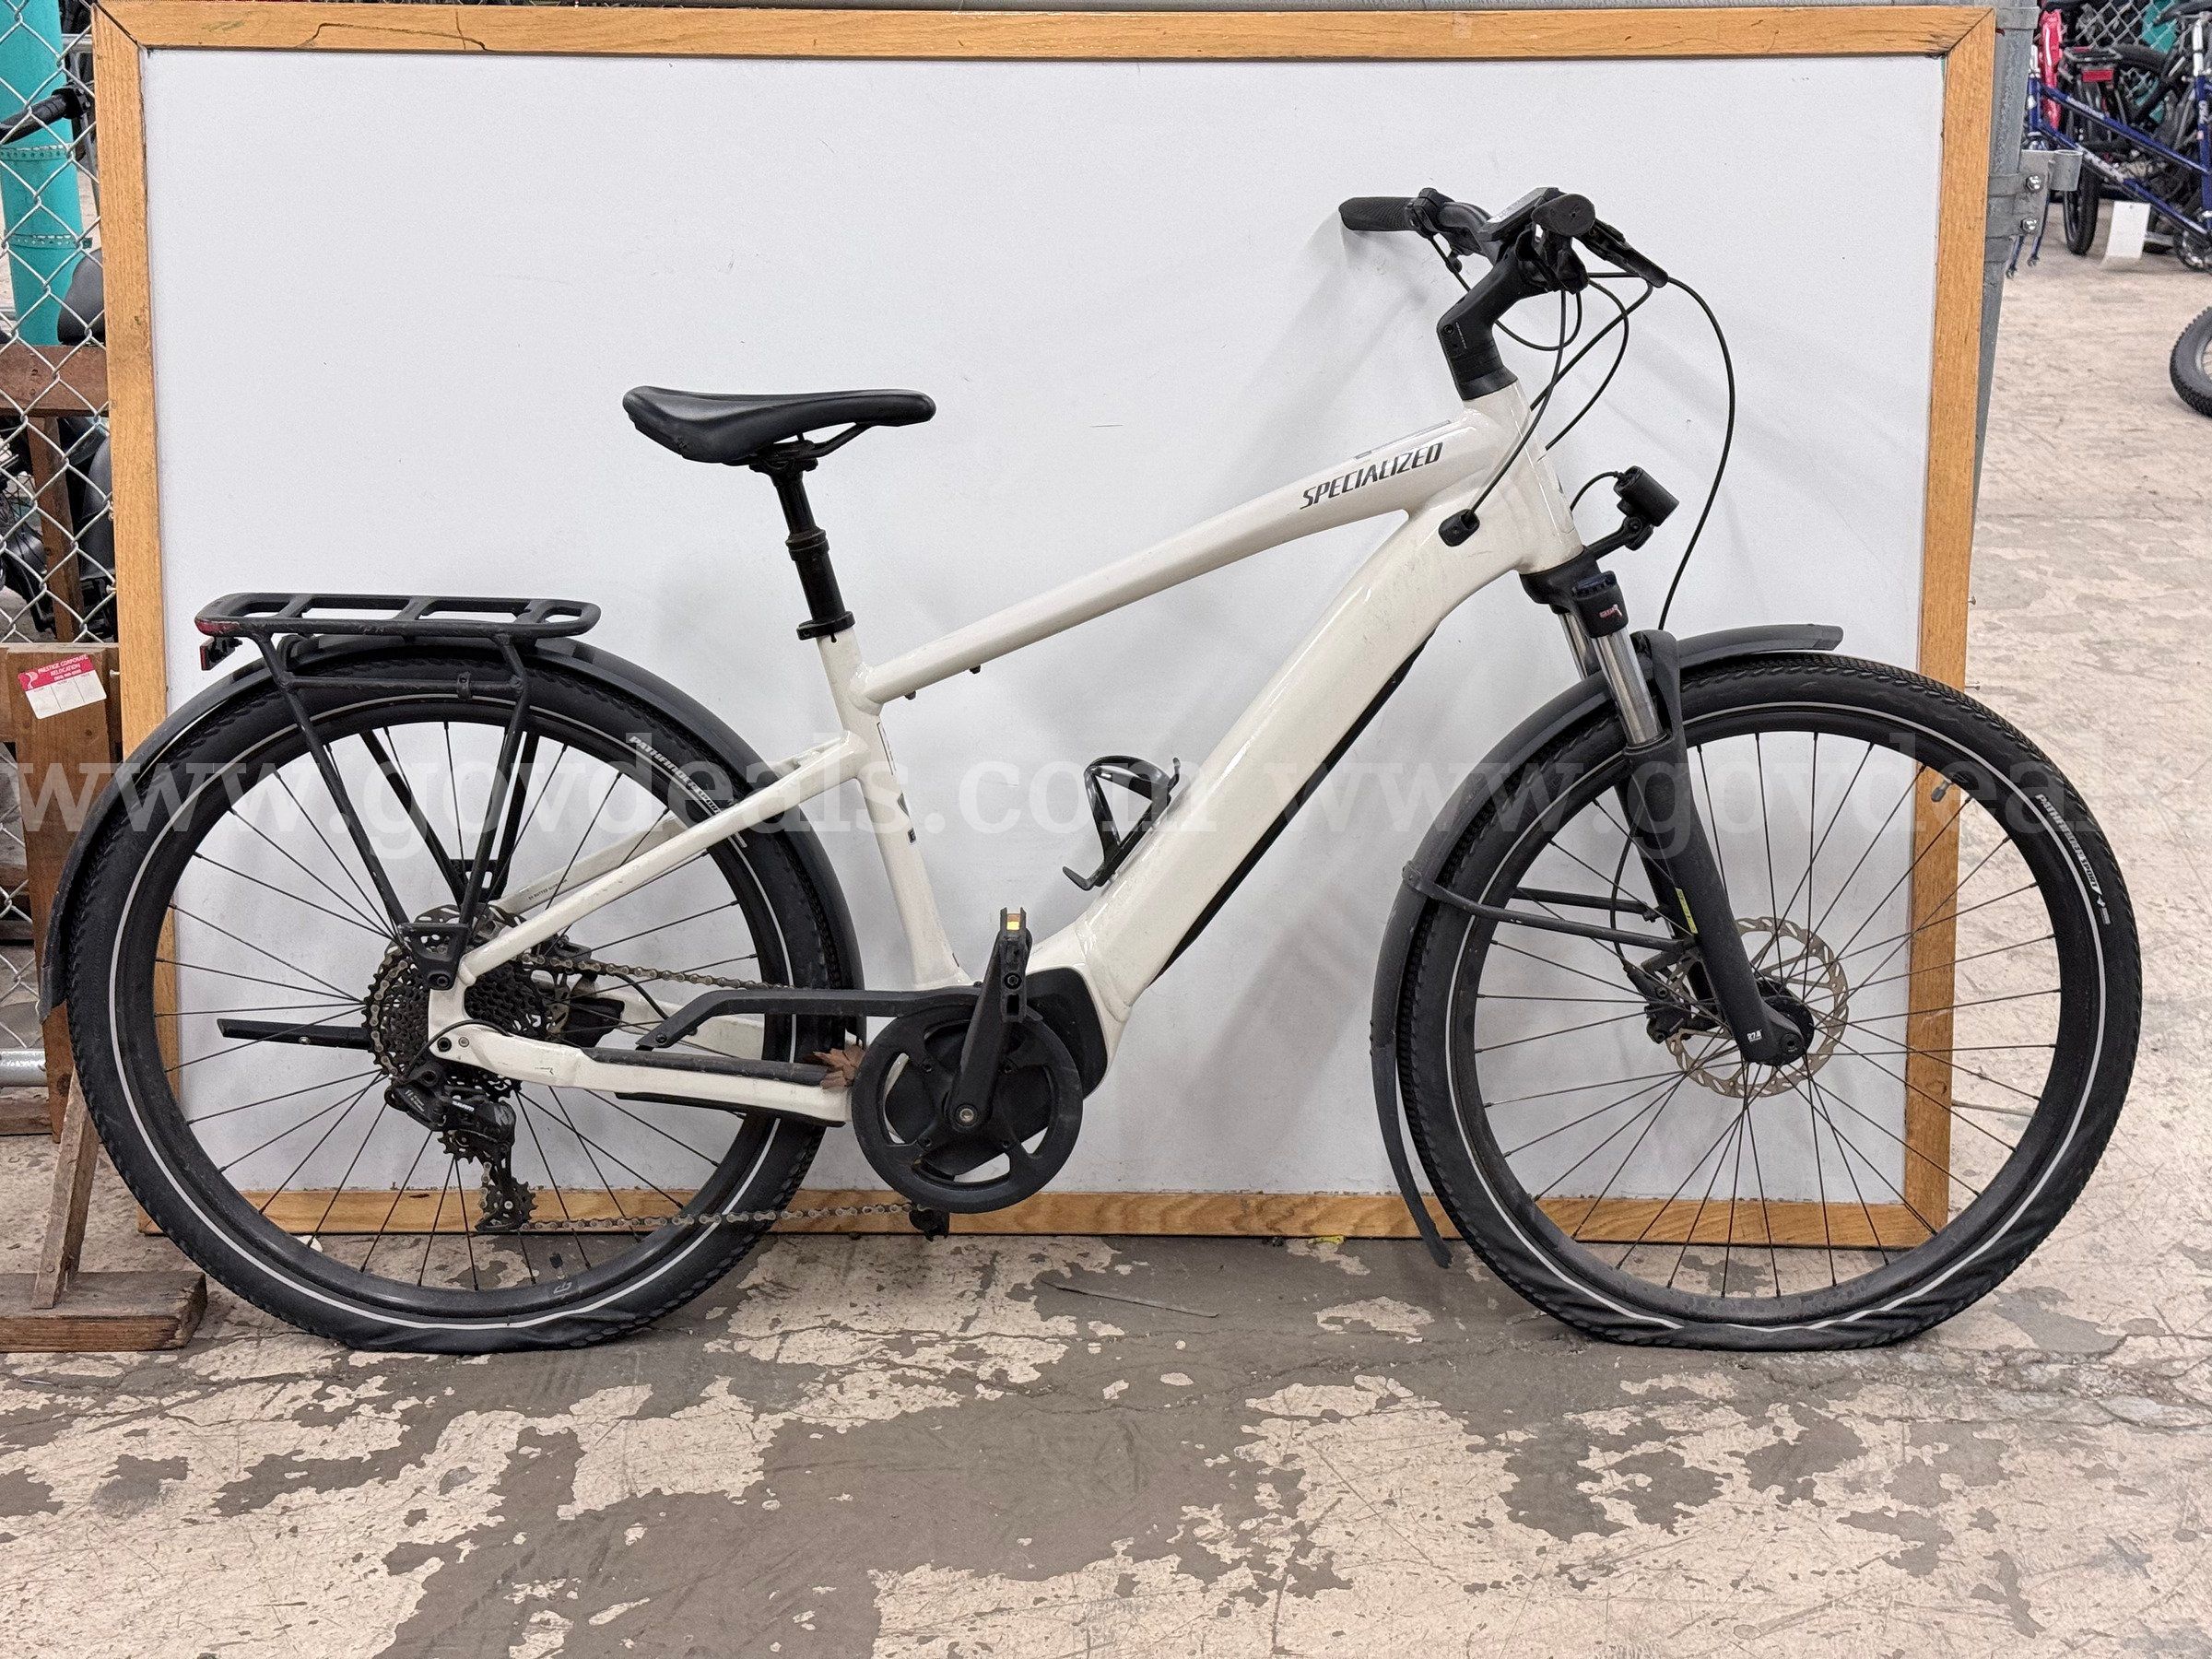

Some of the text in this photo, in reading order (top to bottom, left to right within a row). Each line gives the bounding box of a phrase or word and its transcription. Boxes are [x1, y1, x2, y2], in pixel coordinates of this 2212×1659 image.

[1300, 441, 1443, 510] SPECIALIZED
[50, 663, 81, 677] RELOCATION
[629, 735, 700, 791] PATHFINDER
[2035, 794, 2099, 888] PATHFINDER SPORT
